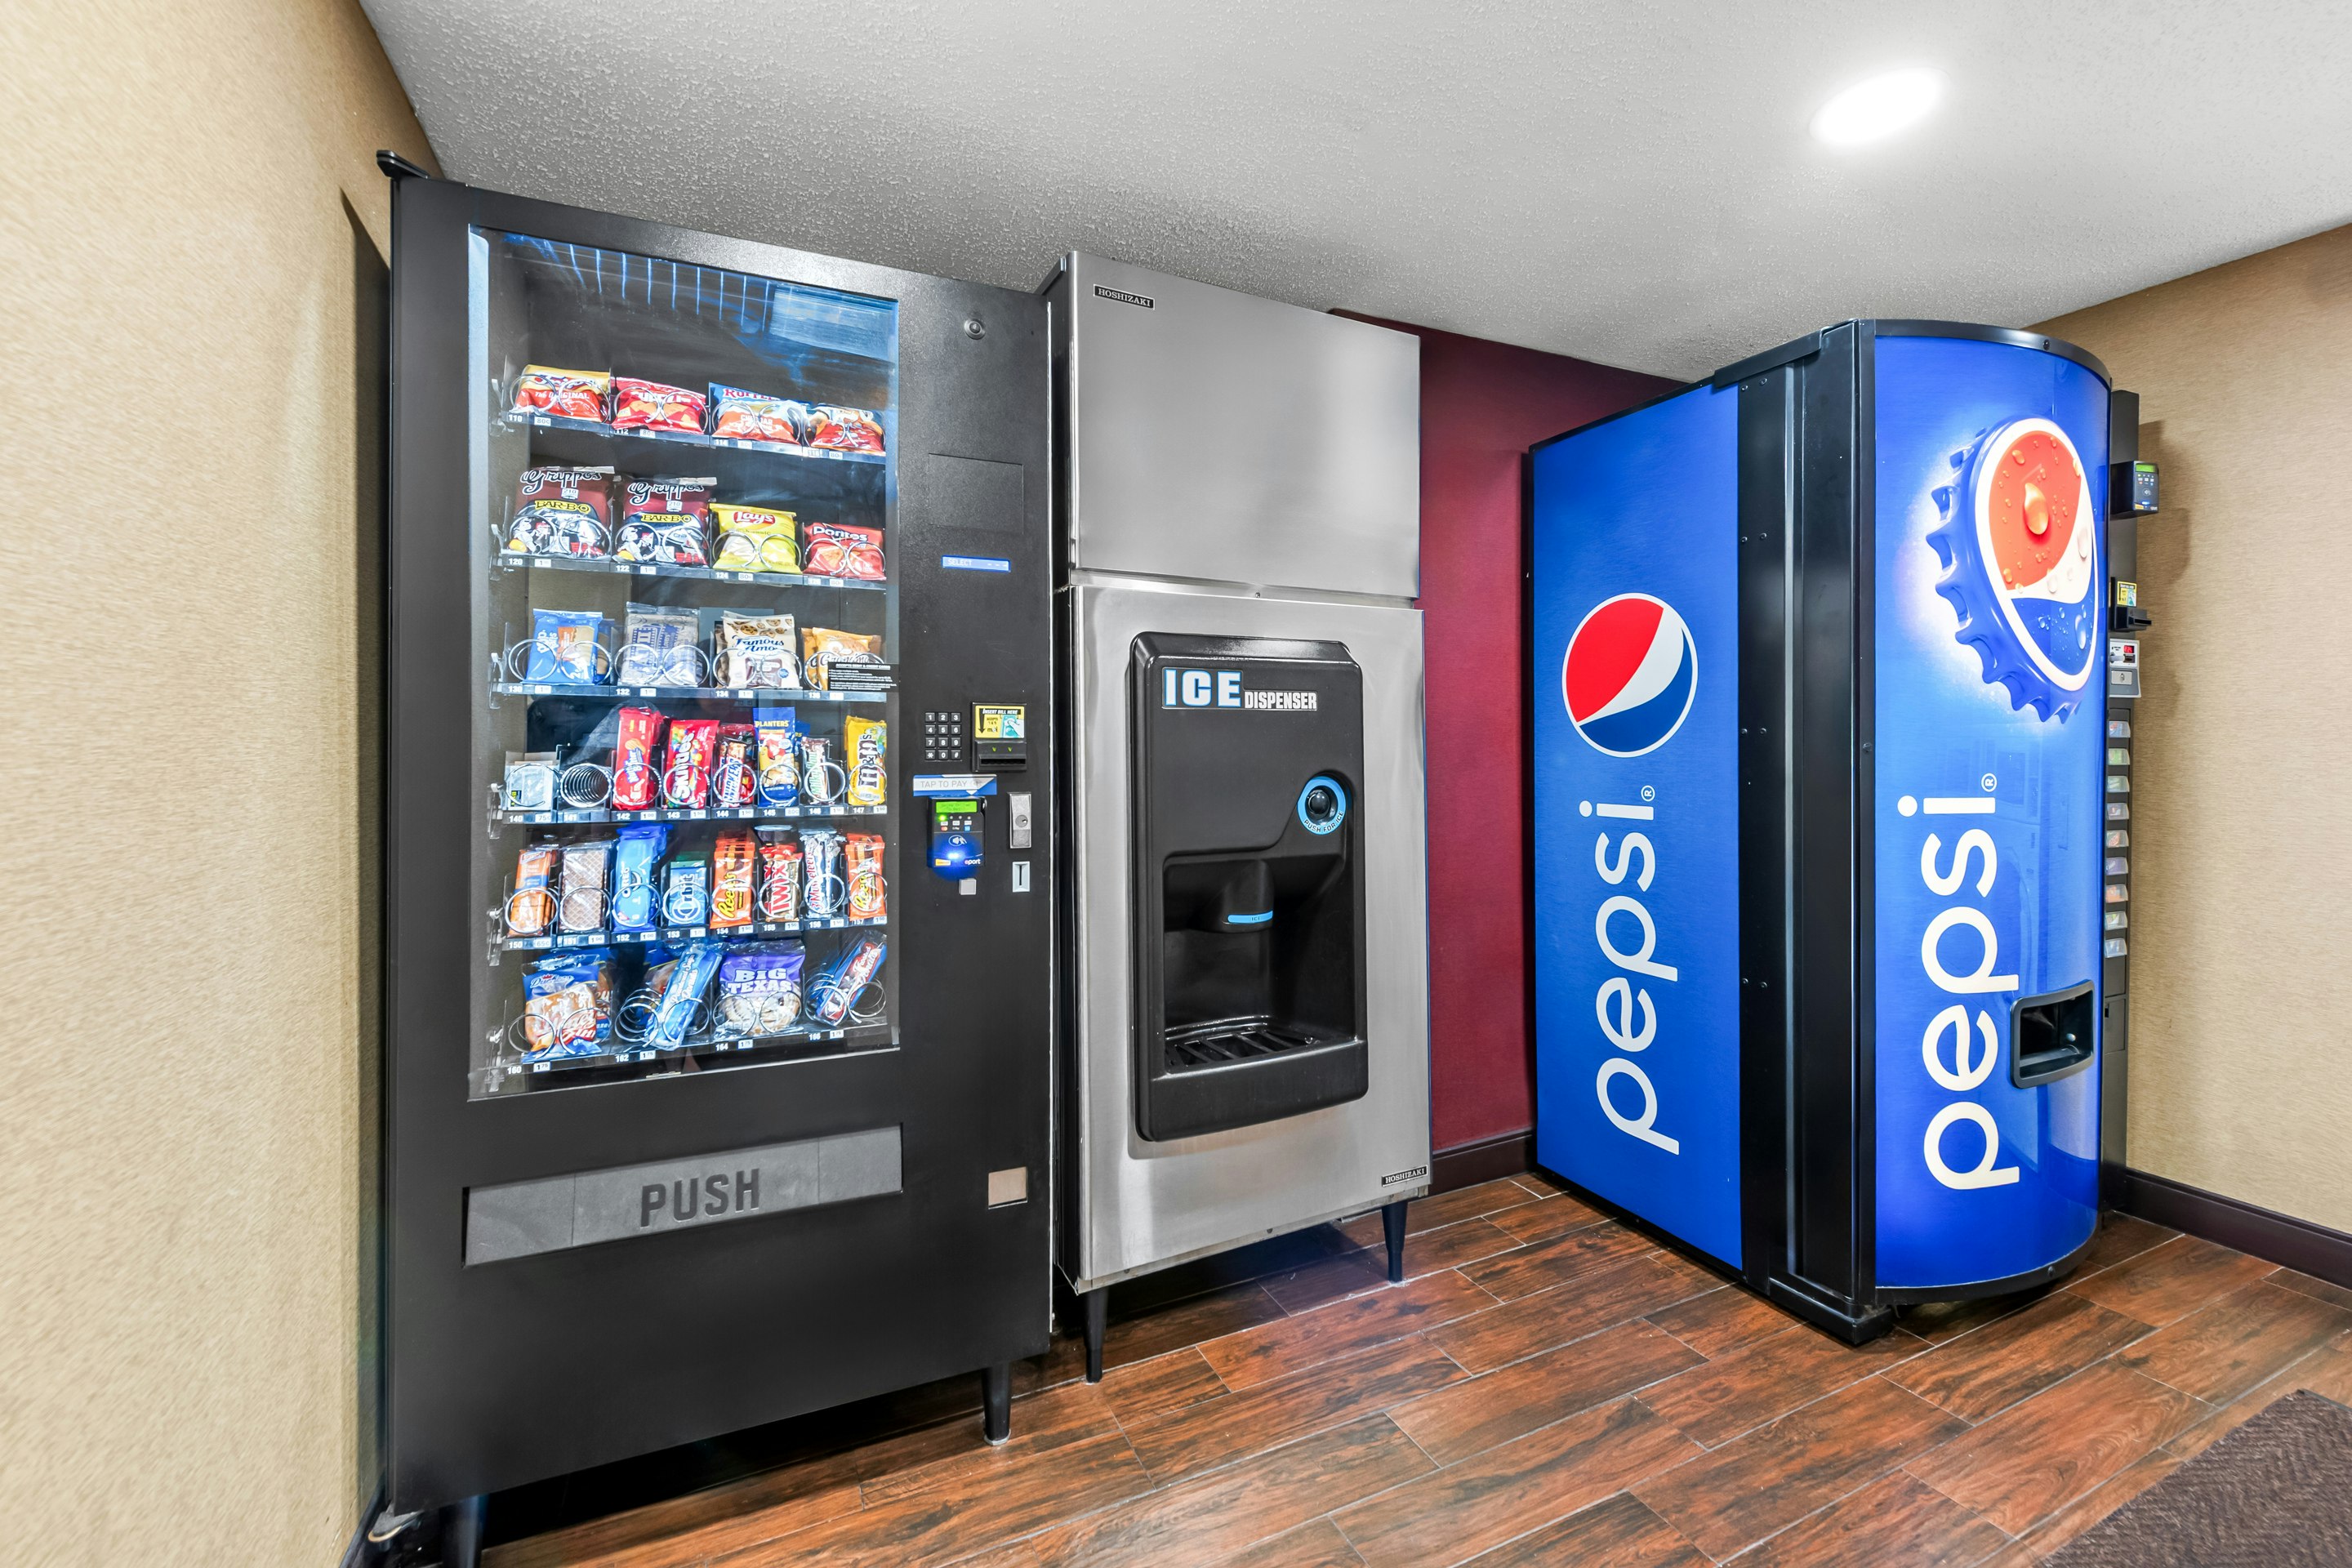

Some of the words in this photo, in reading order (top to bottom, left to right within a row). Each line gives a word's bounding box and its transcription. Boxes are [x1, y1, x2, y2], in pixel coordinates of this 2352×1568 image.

[1098, 287, 1151, 307] HOSHIZAKI
[508, 414, 523, 422] 110
[947, 558, 973, 566] SELECT
[732, 635, 784, 647] Famous
[1165, 669, 1241, 707] ICE
[1244, 691, 1317, 709] DISPENSER
[1303, 819, 1321, 833] PUSH
[1323, 822, 1336, 832] FOR
[1335, 811, 1344, 823] ICE
[735, 968, 787, 982] BIG
[1579, 800, 1680, 1156] pepsi
[727, 980, 792, 995] TEXAS
[1897, 795, 2020, 1190] pepsi
[615, 1054, 629, 1062] 162
[1385, 1168, 1425, 1183] HOSHIZAKI
[640, 1169, 760, 1229] PUSH
